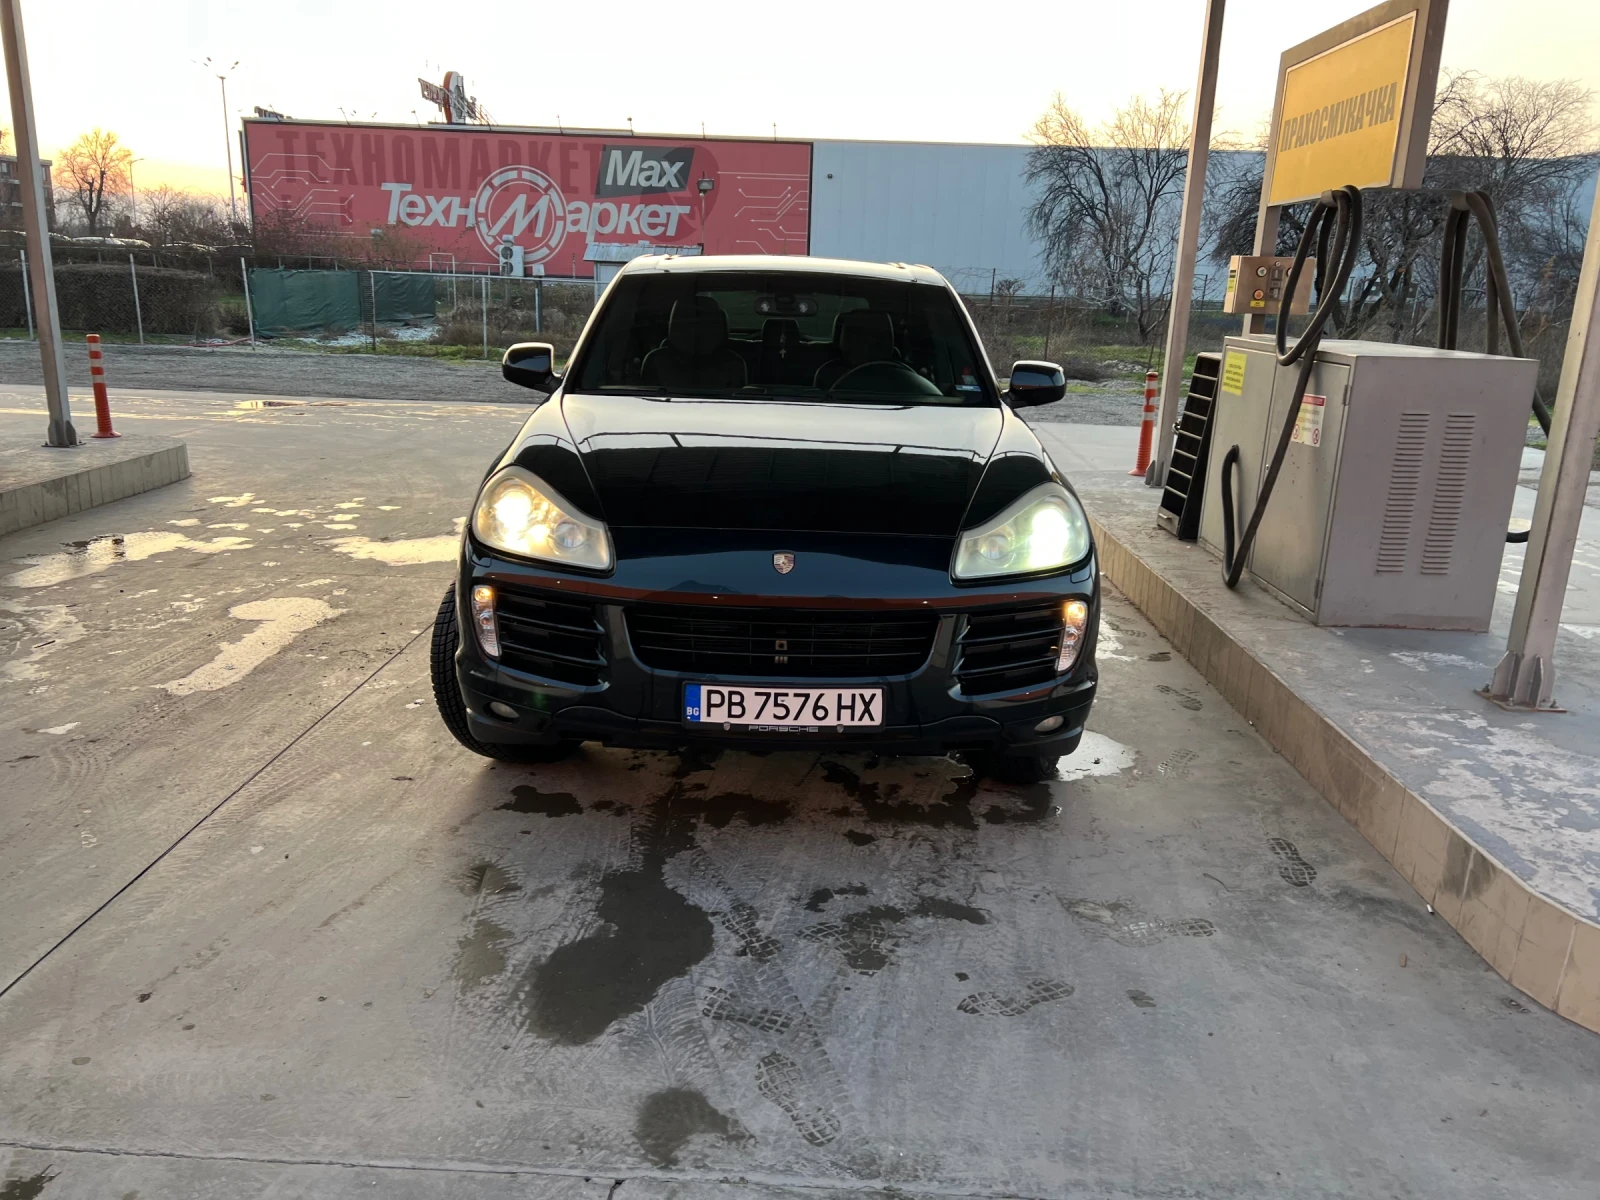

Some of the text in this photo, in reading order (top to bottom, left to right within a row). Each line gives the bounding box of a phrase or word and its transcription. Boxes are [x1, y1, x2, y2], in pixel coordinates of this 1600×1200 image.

[1280, 82, 1398, 152] ПРАХОСМУКАЧКА
[606, 150, 685, 188] Max
[686, 706, 700, 716] BG
[706, 689, 877, 722] PB 7576 HX
[748, 725, 819, 733] PORSCHE
